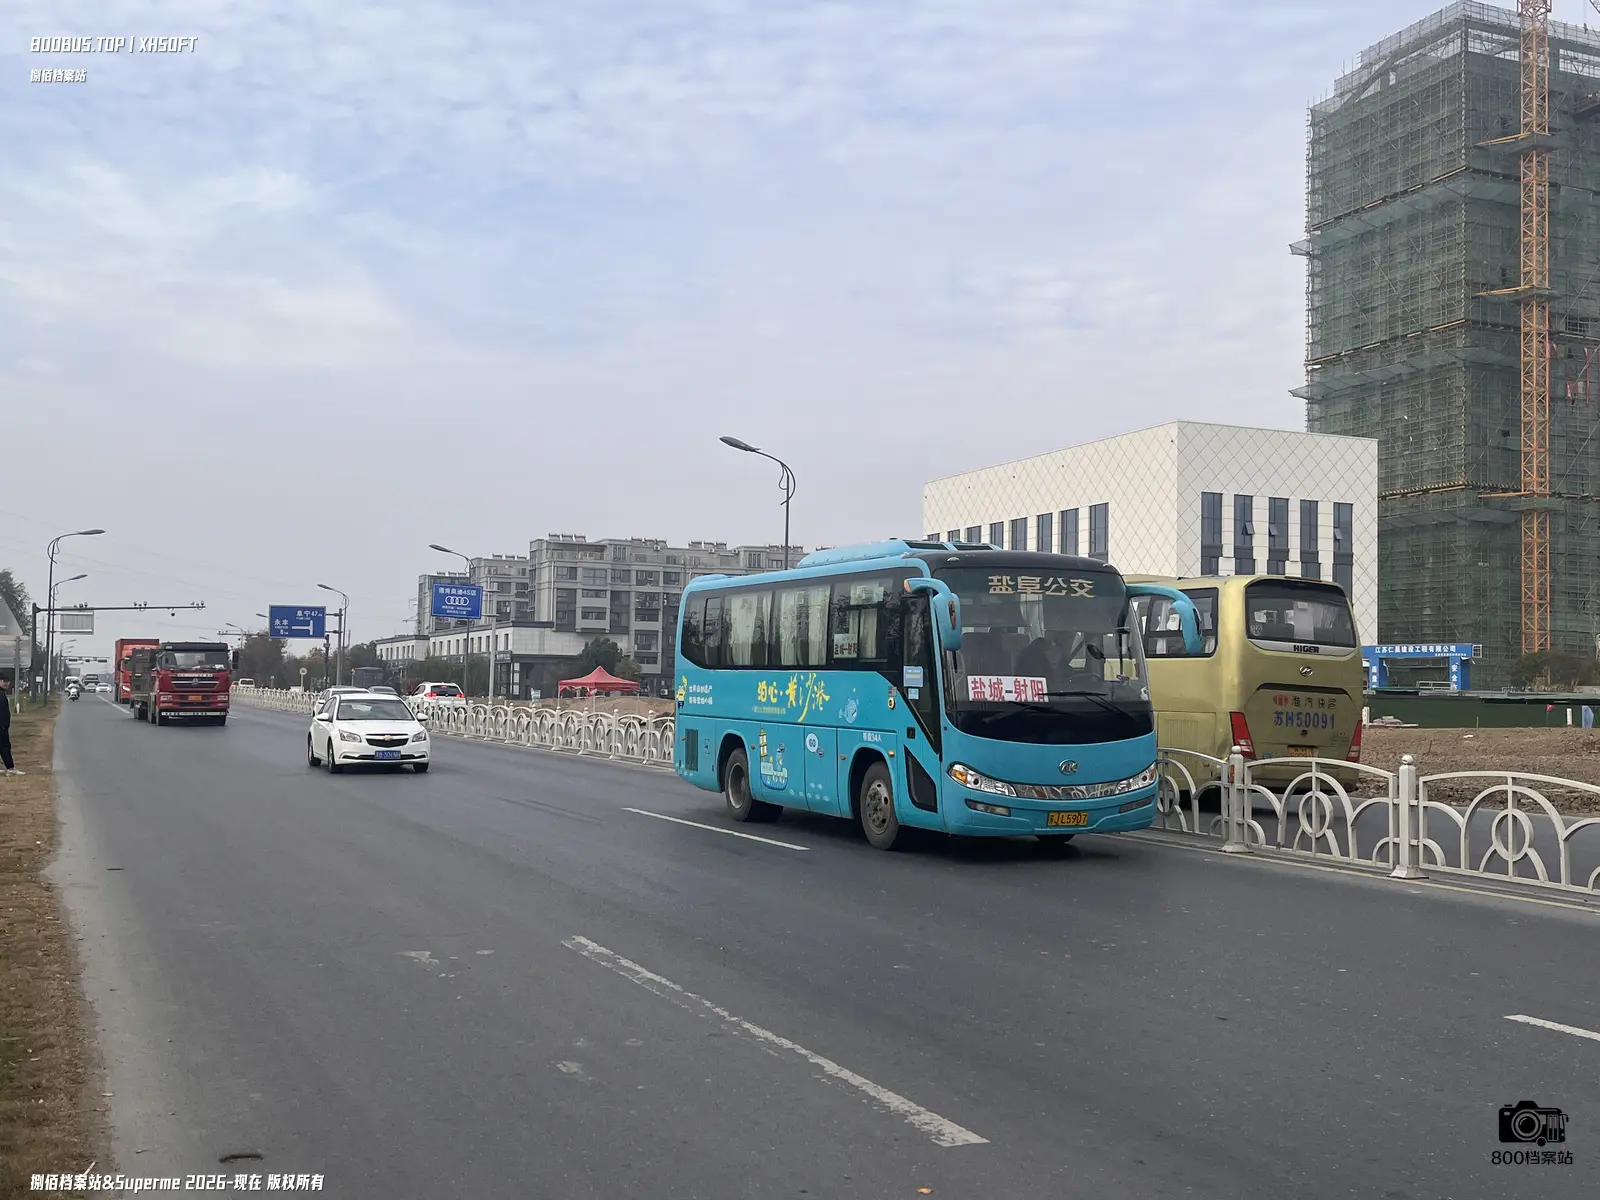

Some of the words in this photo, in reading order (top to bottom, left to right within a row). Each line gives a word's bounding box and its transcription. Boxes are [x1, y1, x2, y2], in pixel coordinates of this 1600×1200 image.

[988, 575, 1096, 598] 盐阜公交
[1293, 645, 1320, 653] HIGER
[971, 677, 1046, 702] 盐城-射阳
[1272, 711, 1335, 729] 苏H50091
